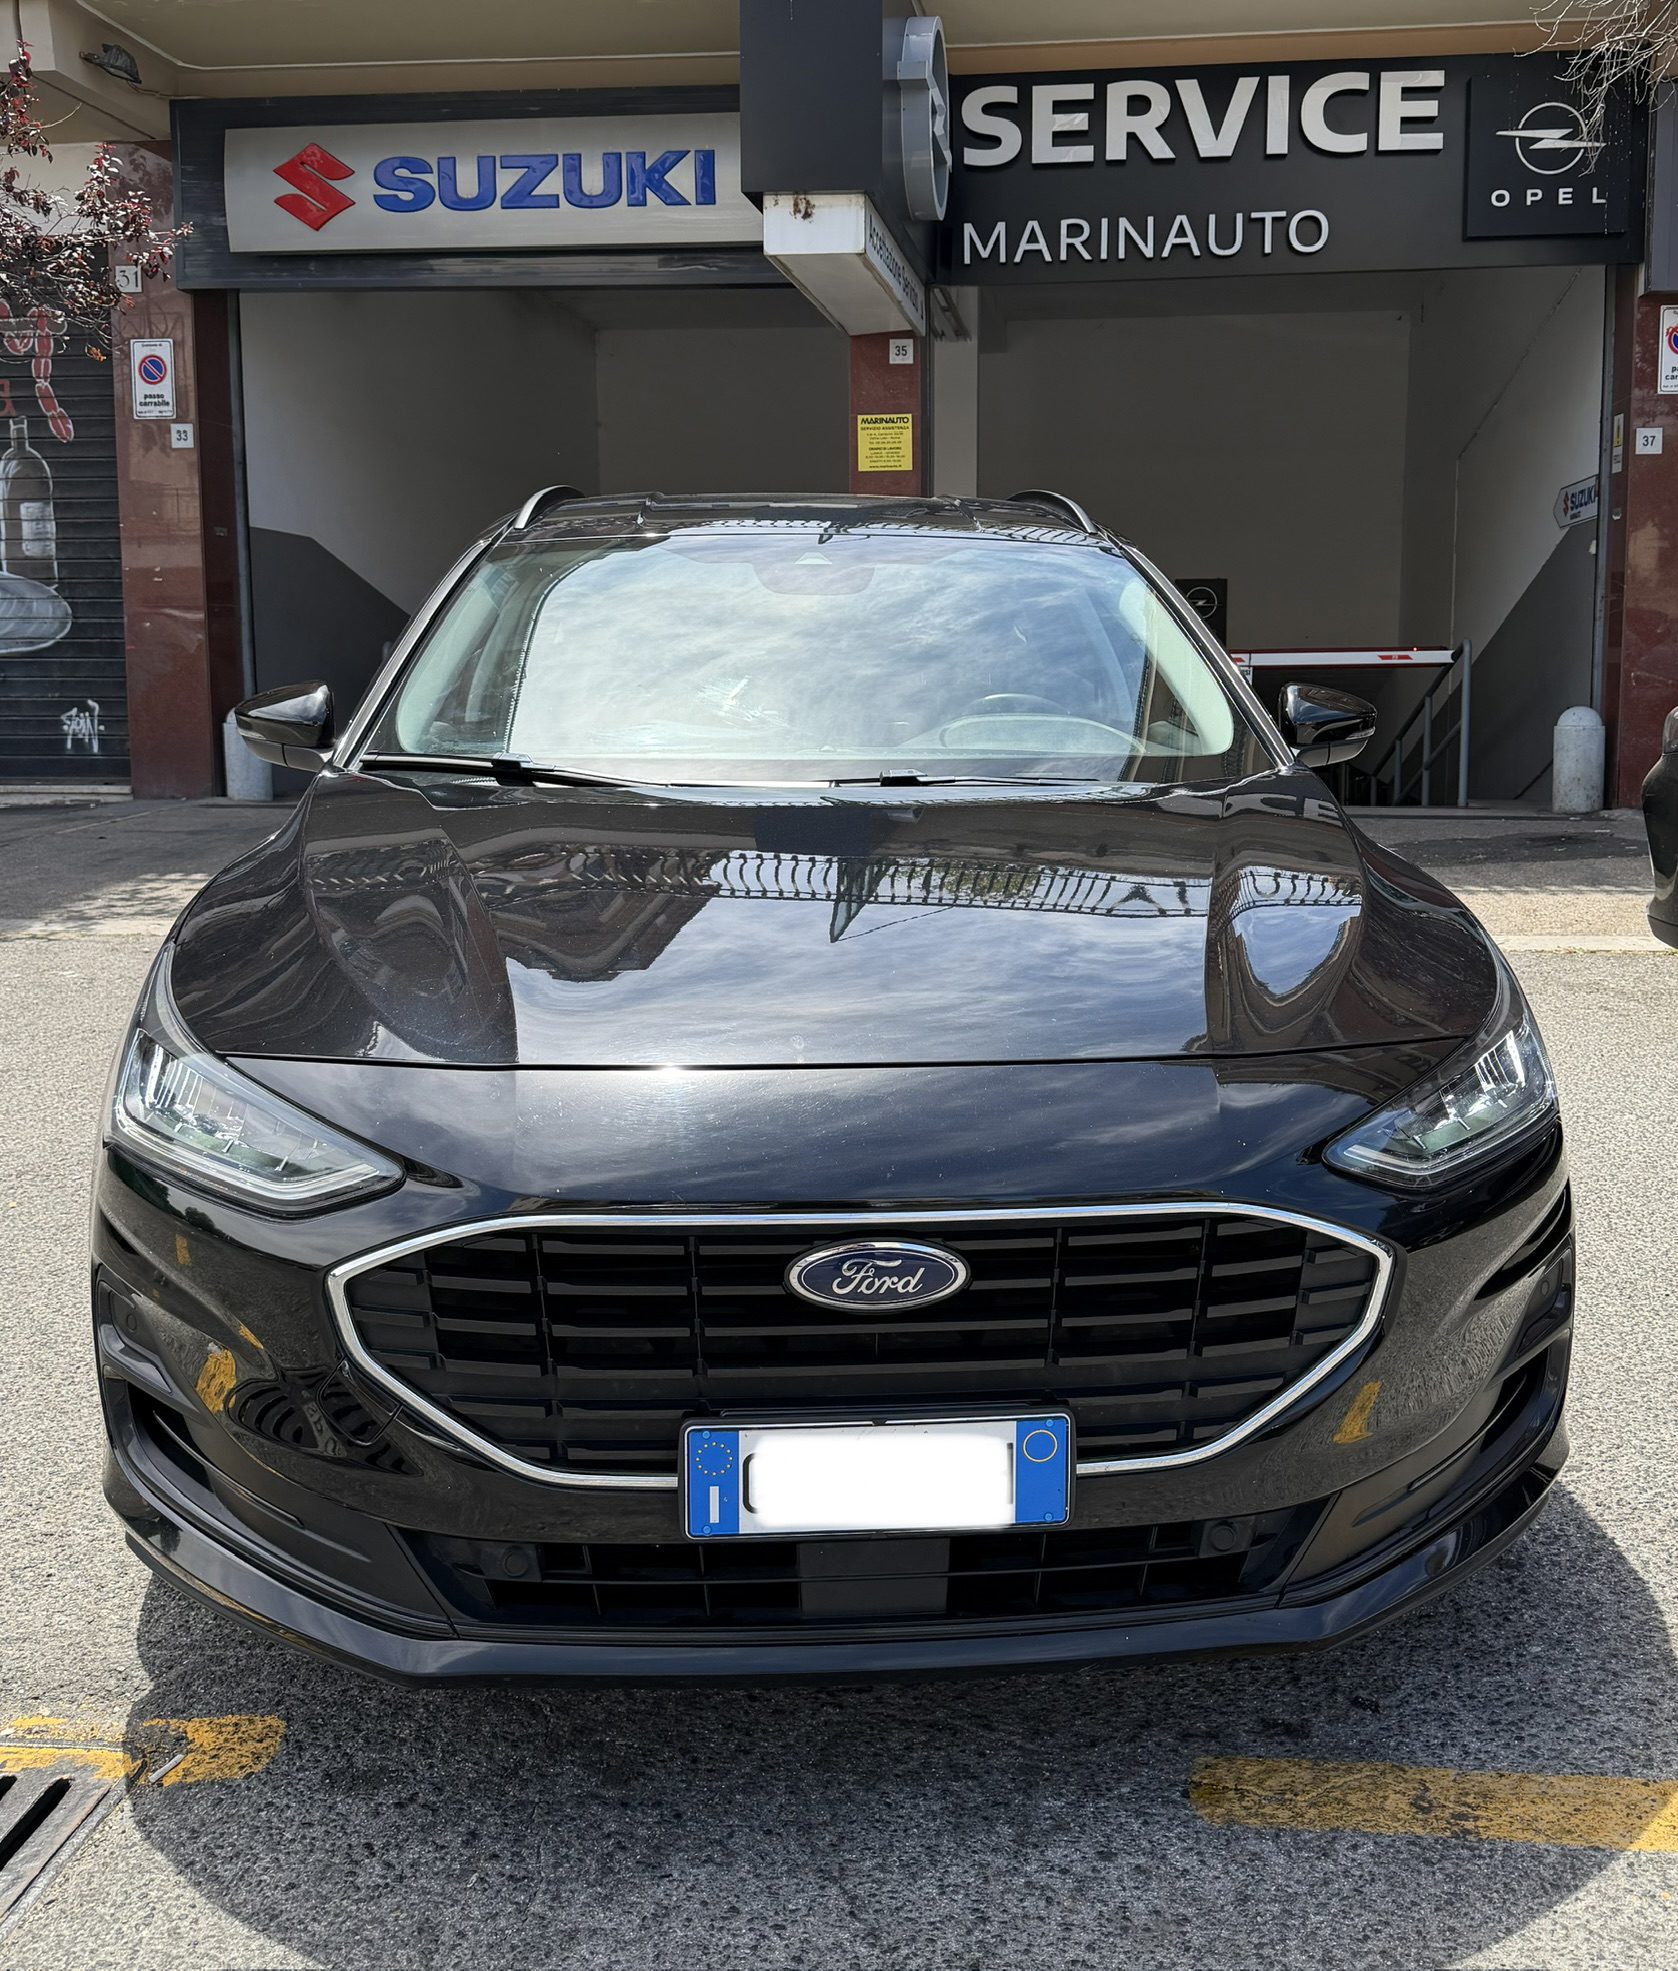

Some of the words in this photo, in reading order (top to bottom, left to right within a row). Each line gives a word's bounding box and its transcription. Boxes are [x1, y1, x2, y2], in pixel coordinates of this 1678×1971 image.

[960, 69, 1445, 167] SERVICE
[373, 149, 717, 213] SUZUKI
[1491, 187, 1607, 207] OPEL
[963, 209, 1330, 265] MARINAUTO
[117, 269, 138, 288] 31
[895, 345, 908, 356] 35
[861, 416, 910, 424] MARINAUTO
[176, 430, 188, 441] 33
[1642, 435, 1656, 447] 37
[1570, 485, 1597, 511] SUZUK
[832, 1258, 926, 1295] Ford
